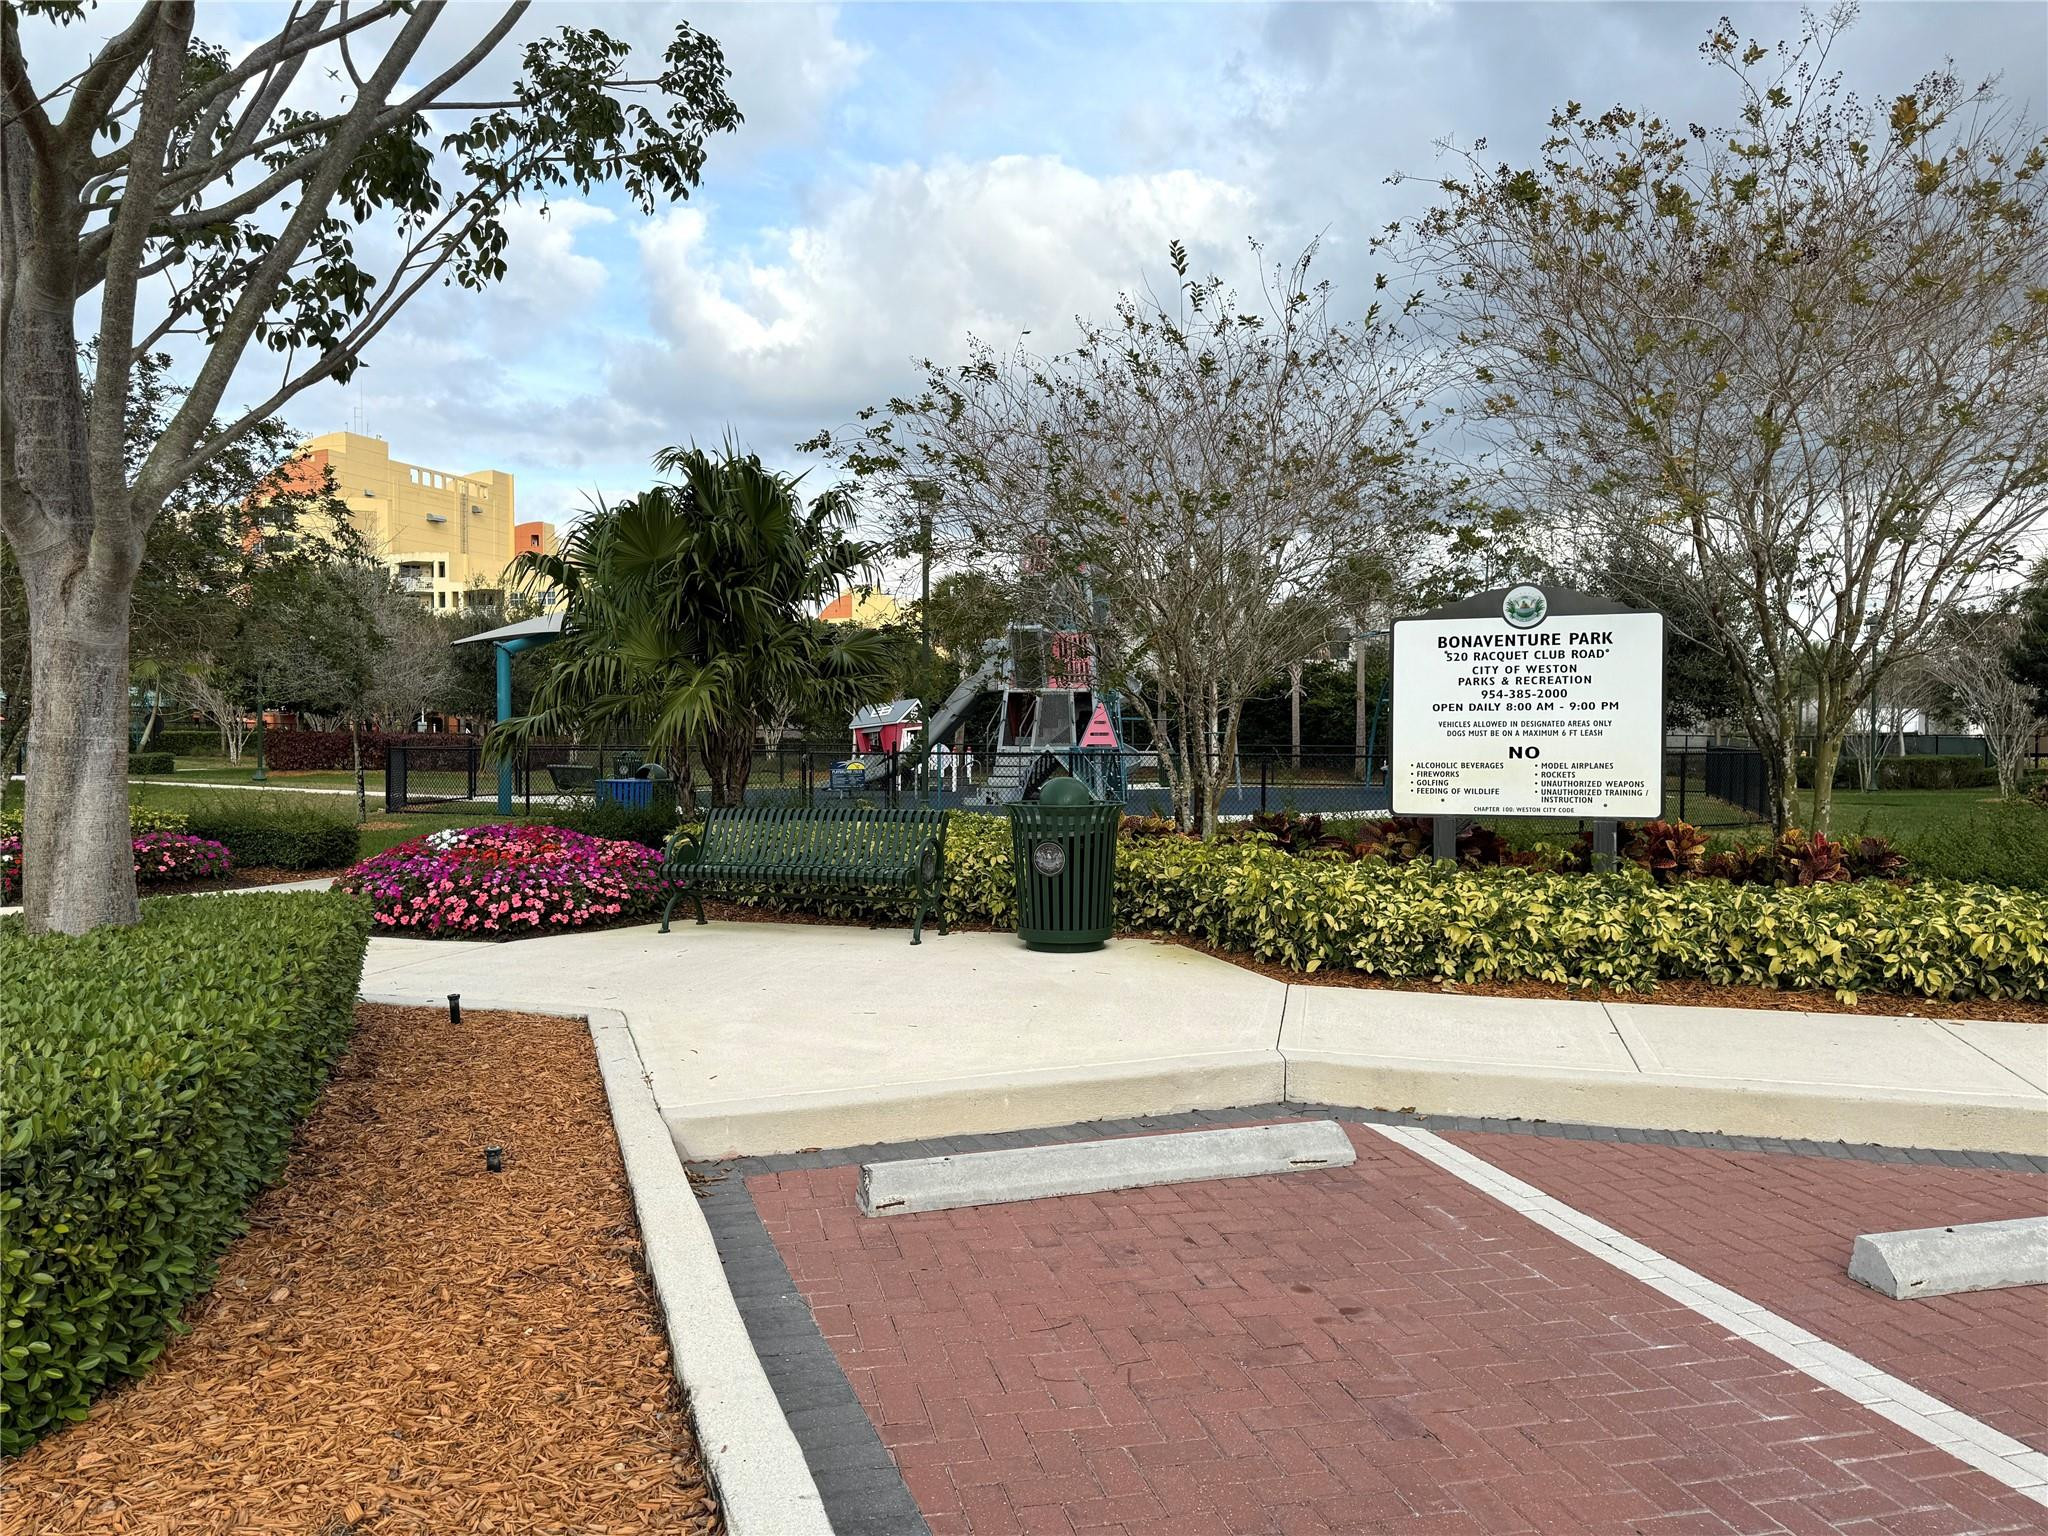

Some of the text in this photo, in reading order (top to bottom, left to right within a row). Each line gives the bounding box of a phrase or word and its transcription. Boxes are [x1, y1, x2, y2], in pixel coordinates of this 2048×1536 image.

[1438, 631, 1613, 649] BONAVENTURE PARK
[1446, 649, 1605, 662] 520 RACQUET CLUB ROAD
[1472, 663, 1577, 675] CITY OF WESTON
[1458, 674, 1591, 686] PARKS & RECREATION
[1481, 688, 1567, 699] 954-385-2000
[1432, 703, 1463, 712] OPEN
[1468, 702, 1501, 711] DAILY
[1505, 702, 1532, 711] 8:00
[1536, 702, 1554, 711] AM
[1569, 701, 1595, 711] 9:00
[1601, 701, 1619, 710] PM
[1520, 719, 1565, 728] DESIGNATED
[1508, 746, 1540, 759] NO
[1460, 761, 1504, 769] BEVERAGES
[1540, 770, 1576, 778] ROCKETS
[1604, 788, 1643, 796] TRAINING
[1541, 796, 1593, 804] INSTRUCTION
